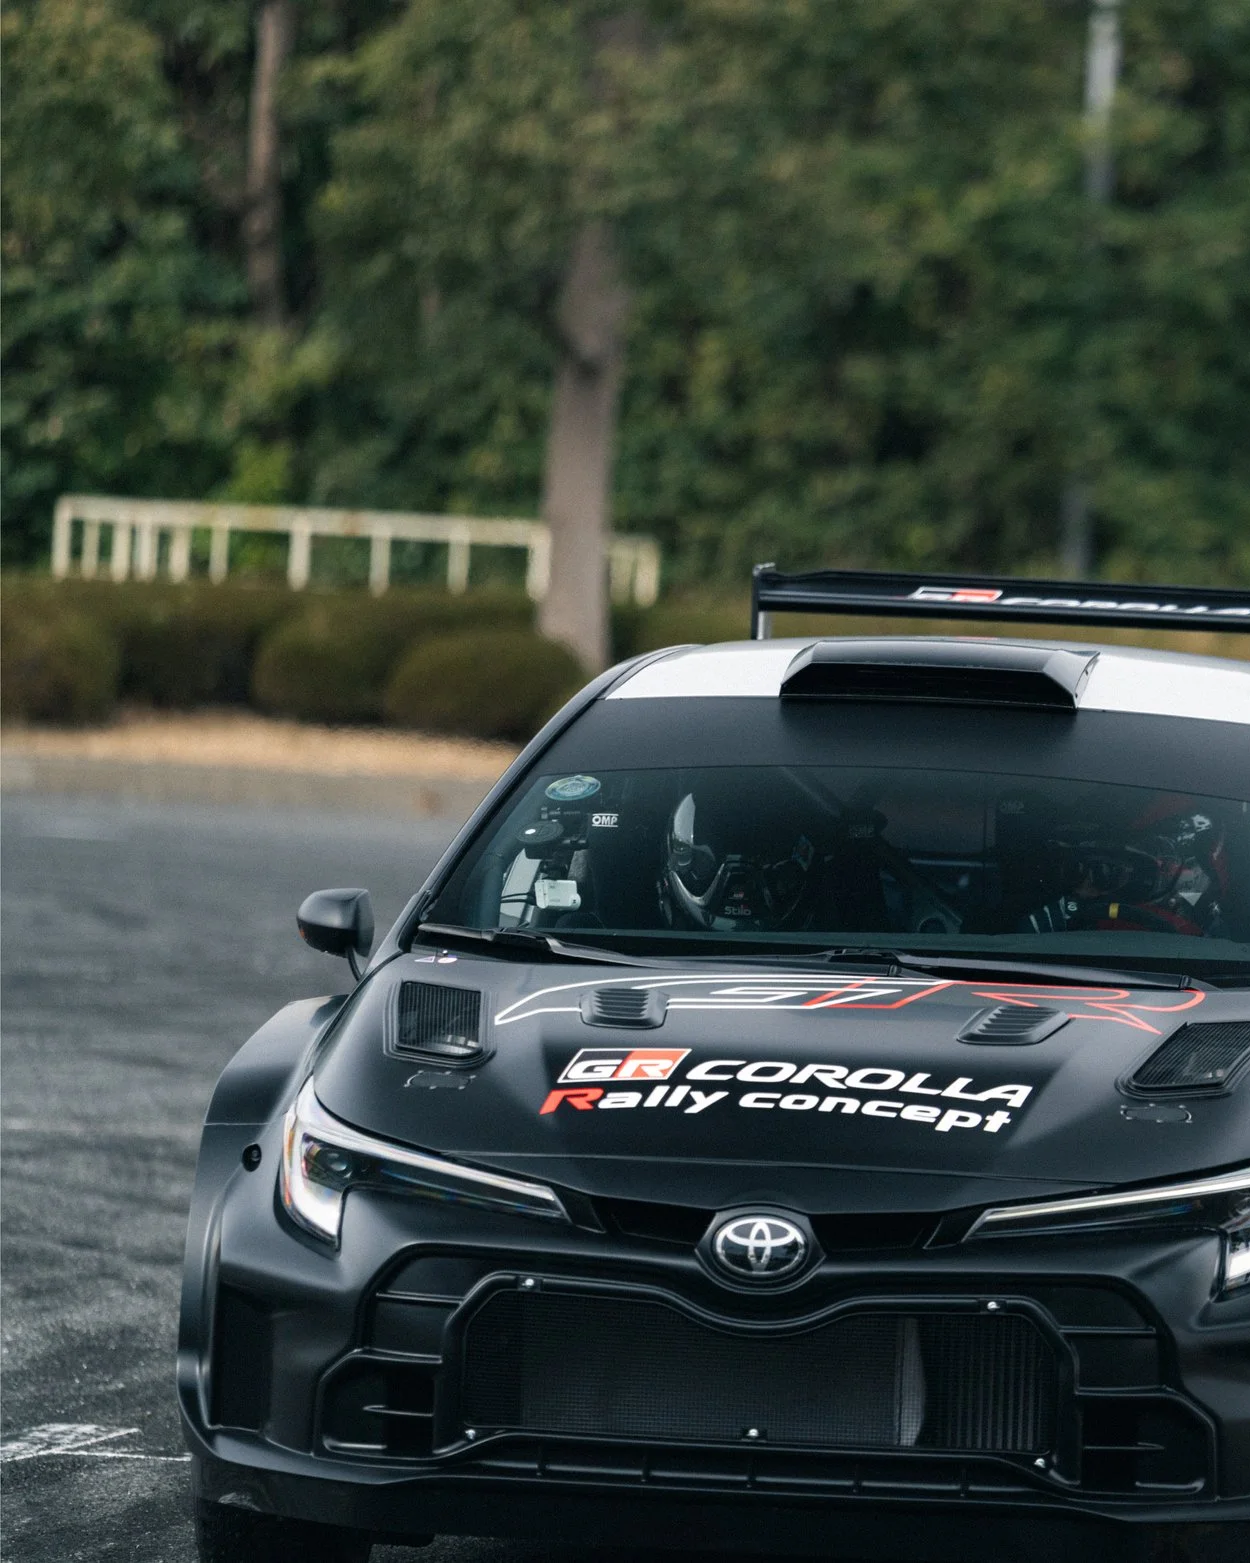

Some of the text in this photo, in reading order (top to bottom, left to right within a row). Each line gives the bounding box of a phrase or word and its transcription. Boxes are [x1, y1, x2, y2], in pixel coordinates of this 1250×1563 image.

[591, 815, 619, 826] OMP
[563, 1056, 1033, 1108] GR COROLLA
[540, 1084, 1013, 1134] Rally concept
